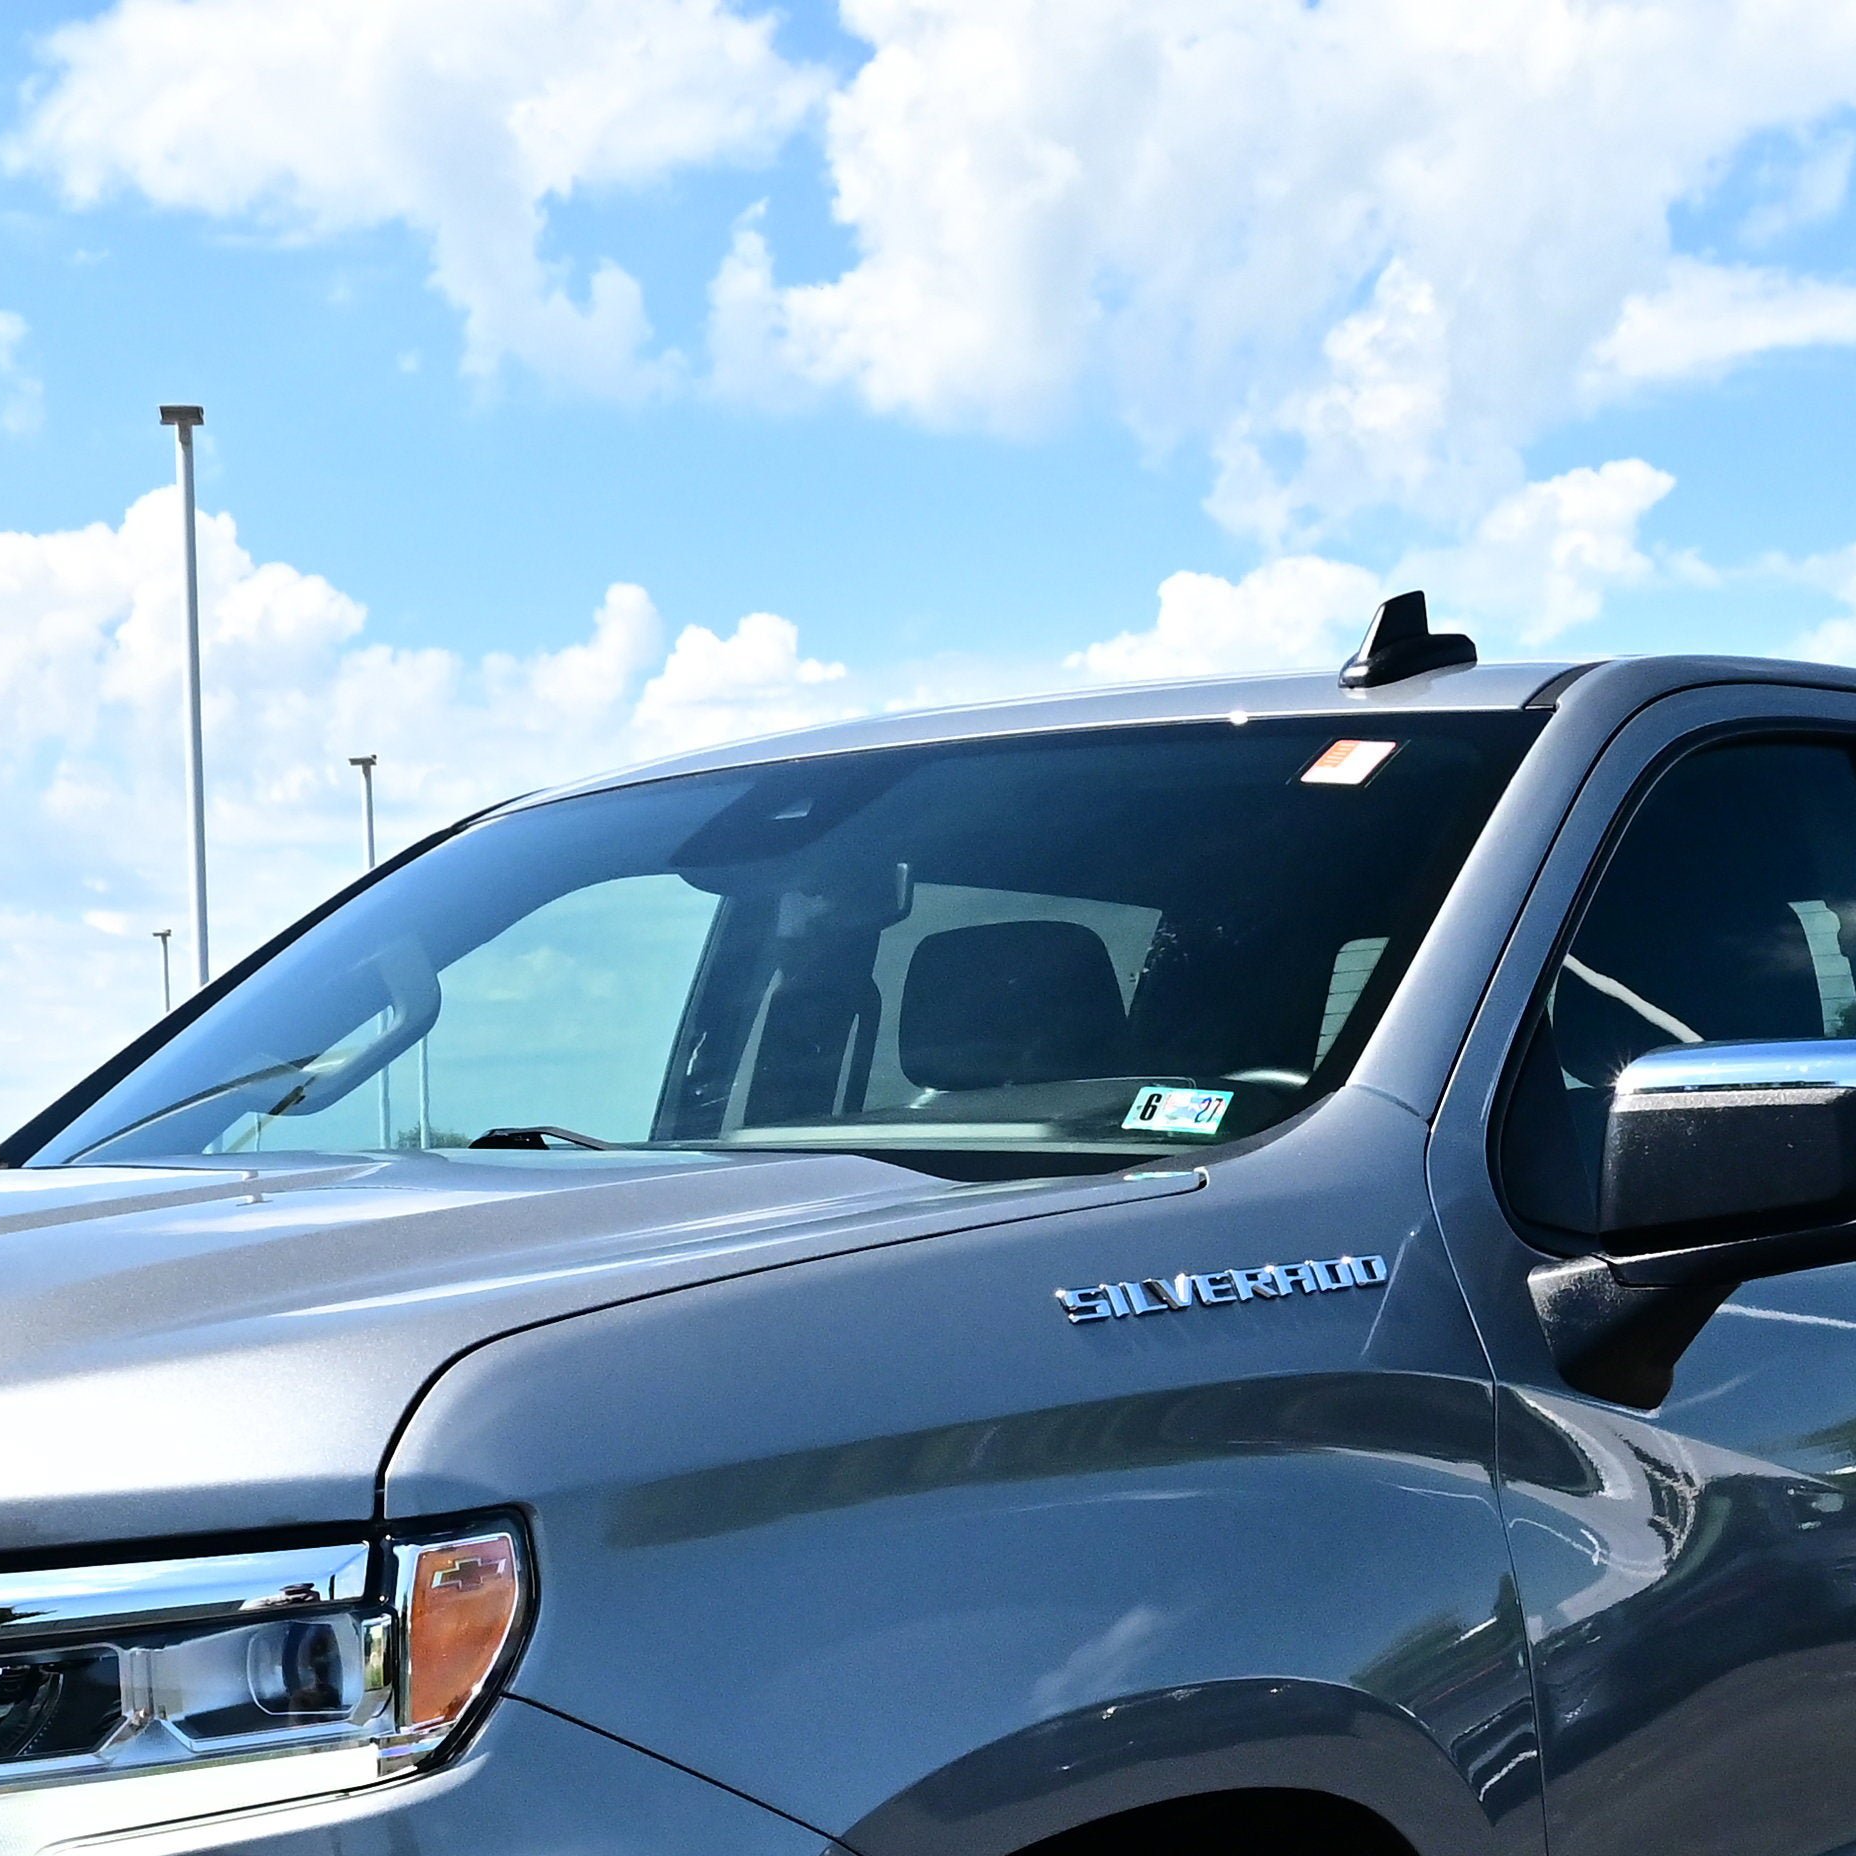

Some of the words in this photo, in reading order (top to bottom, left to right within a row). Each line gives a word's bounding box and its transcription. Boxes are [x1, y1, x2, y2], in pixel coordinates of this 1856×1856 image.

[1139, 1093, 1162, 1121] 6
[1194, 1097, 1223, 1123] 27
[1054, 1254, 1389, 1324] SILVERADO
